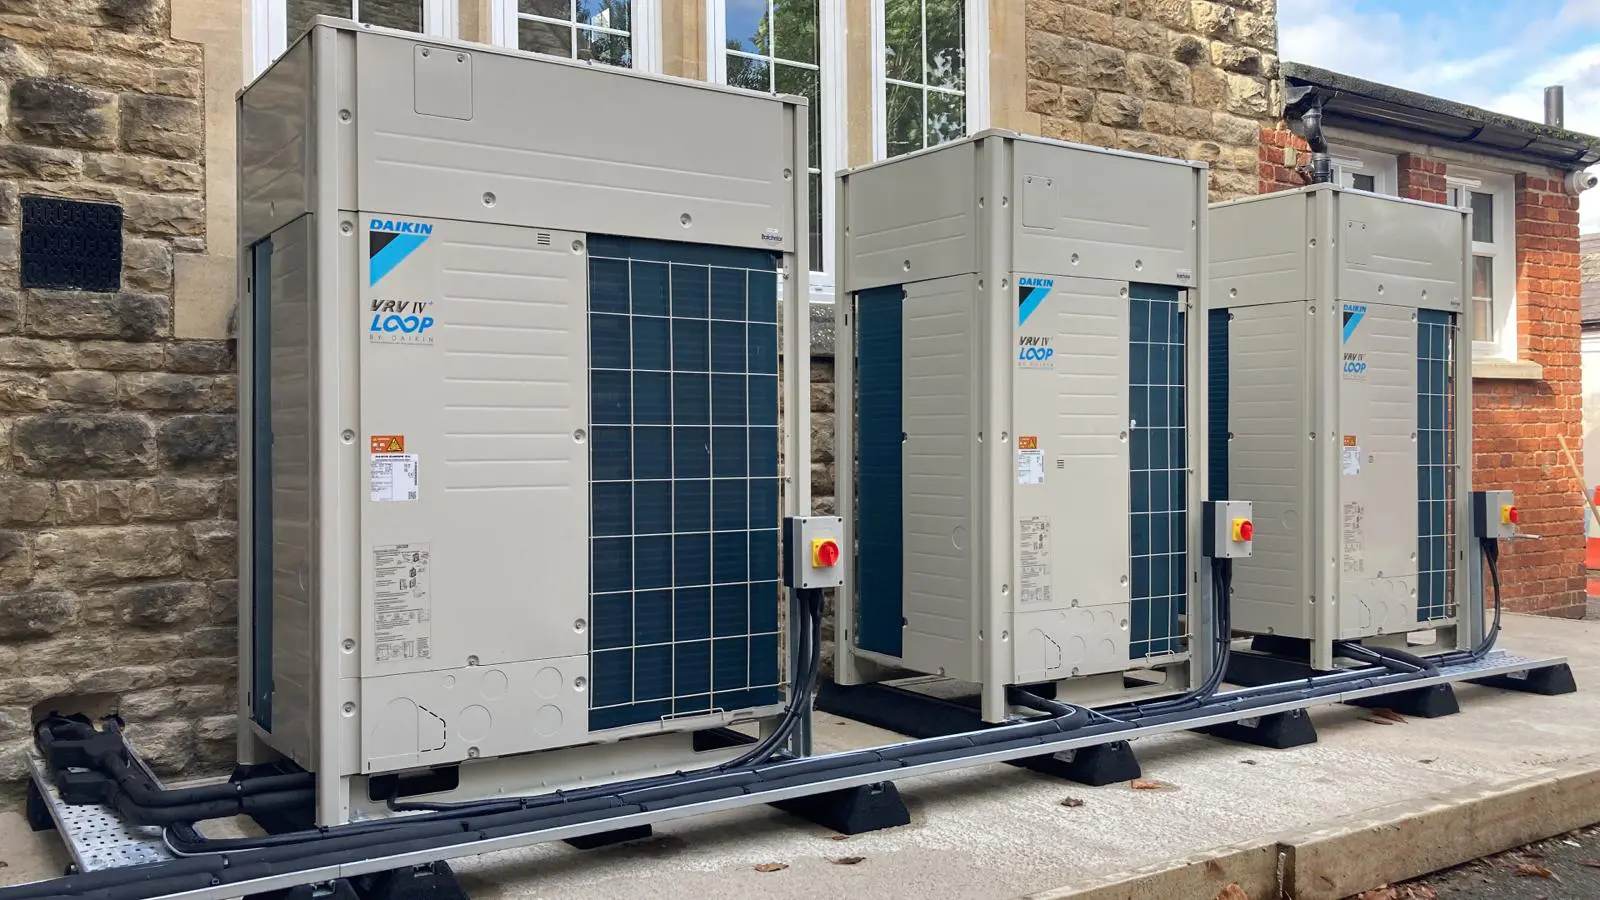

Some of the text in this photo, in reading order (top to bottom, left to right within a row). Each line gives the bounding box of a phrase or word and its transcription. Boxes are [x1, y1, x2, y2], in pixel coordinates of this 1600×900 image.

[370, 219, 433, 234] DAIKIN
[1019, 277, 1054, 287] DAIKIN
[370, 300, 409, 313] VRV
[1344, 304, 1367, 312] DAIKIN
[370, 314, 434, 333] LOOP
[1019, 336, 1040, 346] VRV
[1019, 347, 1053, 361] LOOP
[1344, 361, 1367, 373] LOOP
